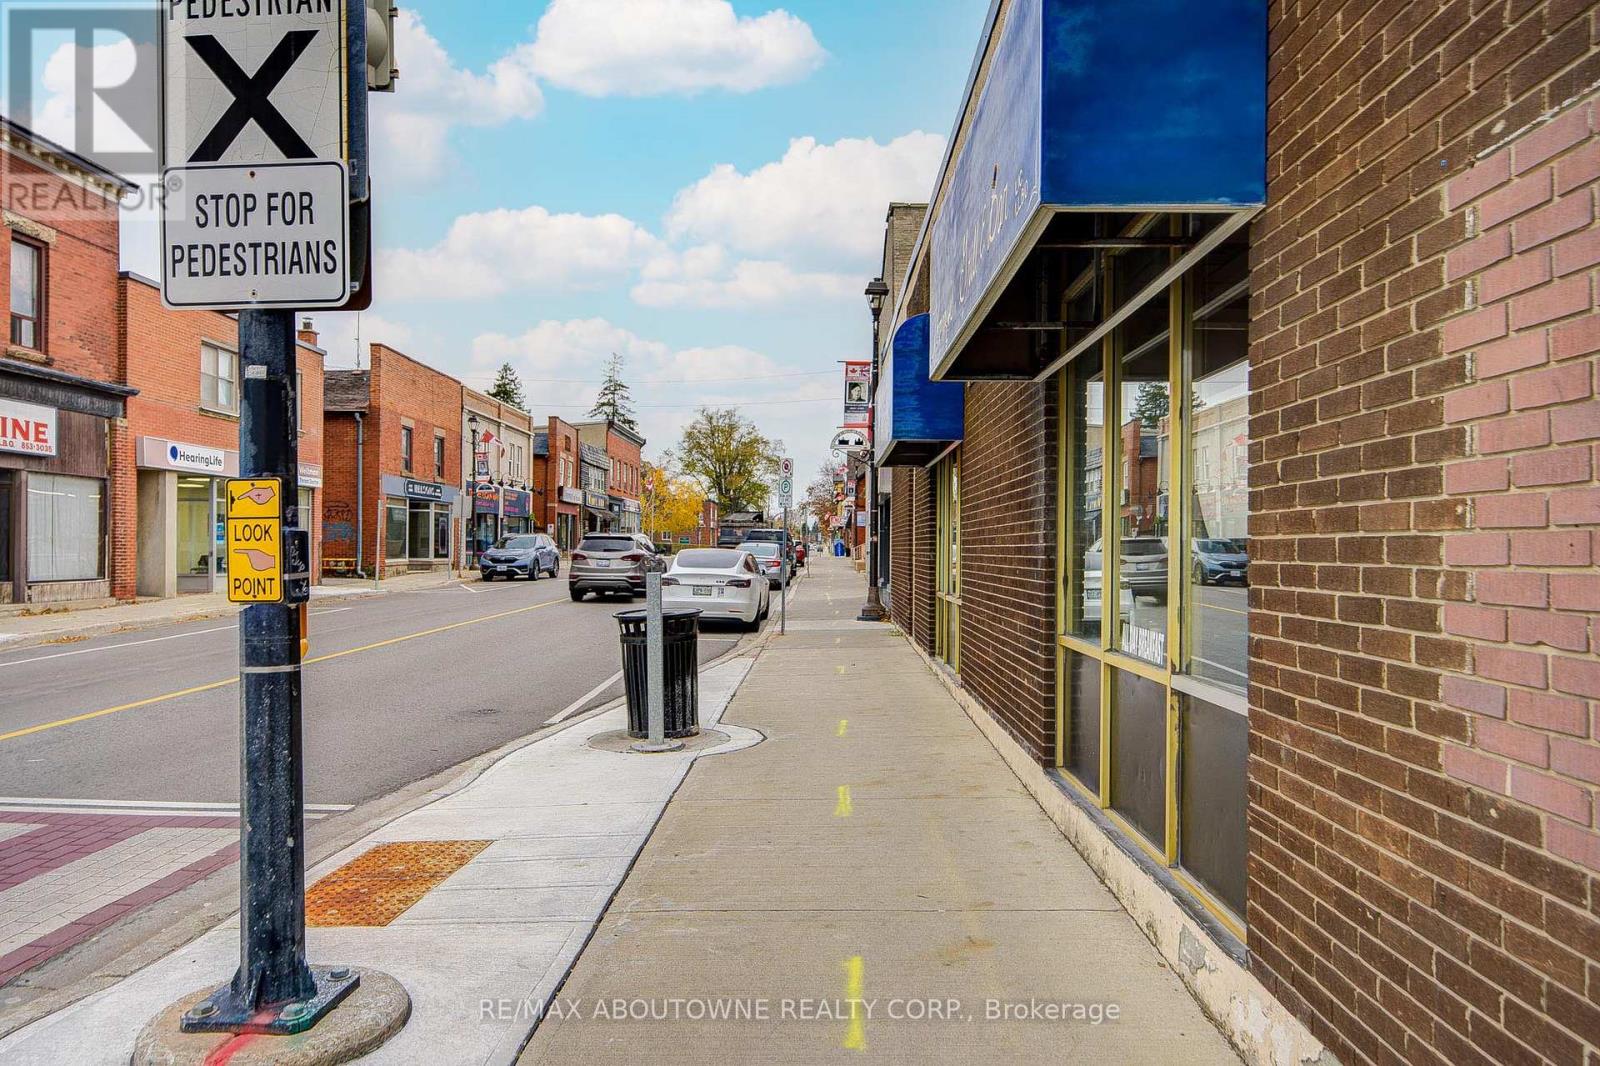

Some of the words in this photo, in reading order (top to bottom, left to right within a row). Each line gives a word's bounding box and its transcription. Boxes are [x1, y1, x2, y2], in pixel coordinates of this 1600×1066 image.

[195, 193, 257, 229] STOP
[267, 191, 315, 226] FOR
[171, 240, 338, 278] PEDESTRIANS
[179, 450, 223, 467] HearingLife
[234, 524, 273, 541] LOOK
[233, 578, 275, 596] POINT
